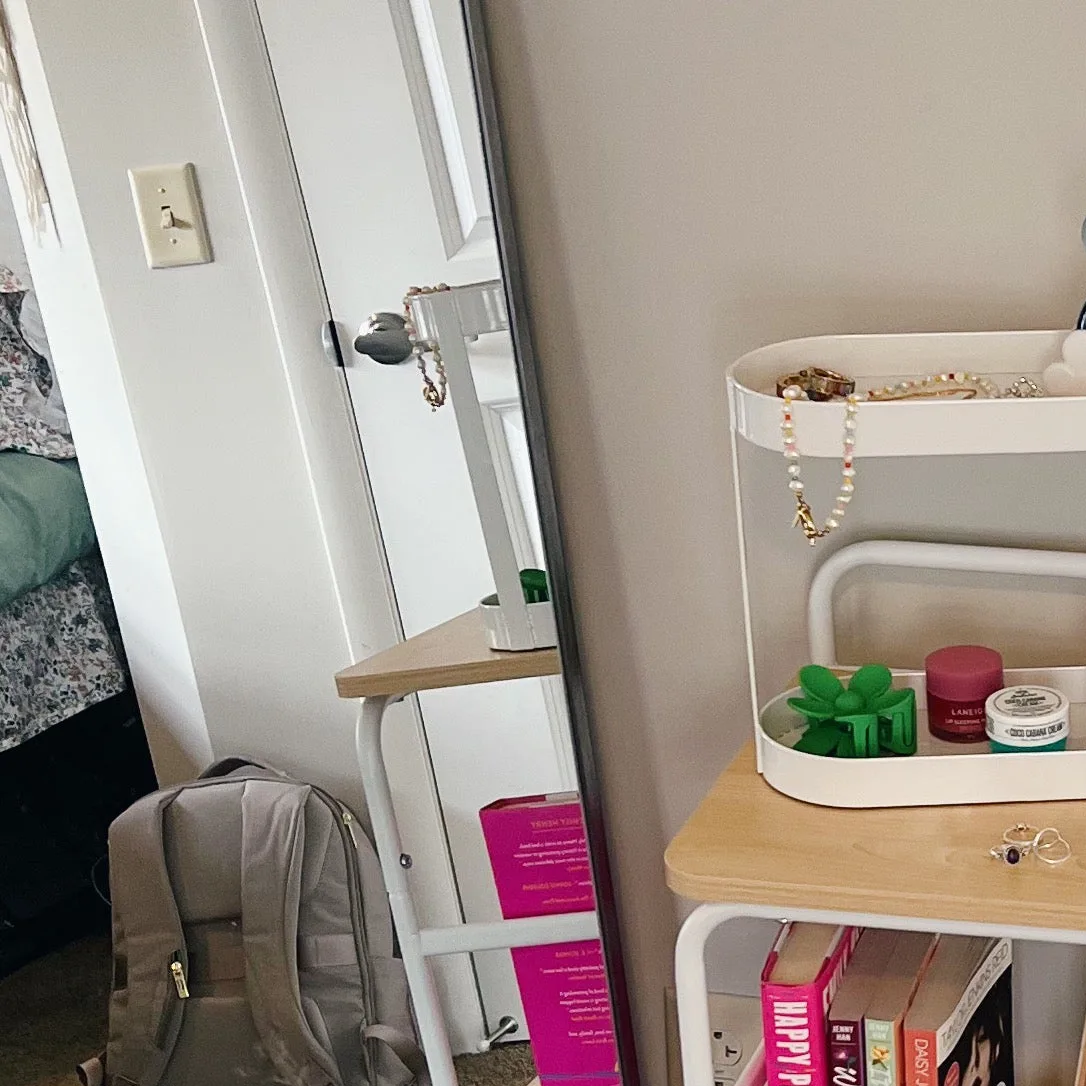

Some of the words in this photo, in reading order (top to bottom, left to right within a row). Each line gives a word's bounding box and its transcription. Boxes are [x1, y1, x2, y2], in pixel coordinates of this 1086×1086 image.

[951, 708, 983, 716] LANEIG
[773, 1001, 811, 1066] HAPPY
[915, 1038, 929, 1077] DAISY
